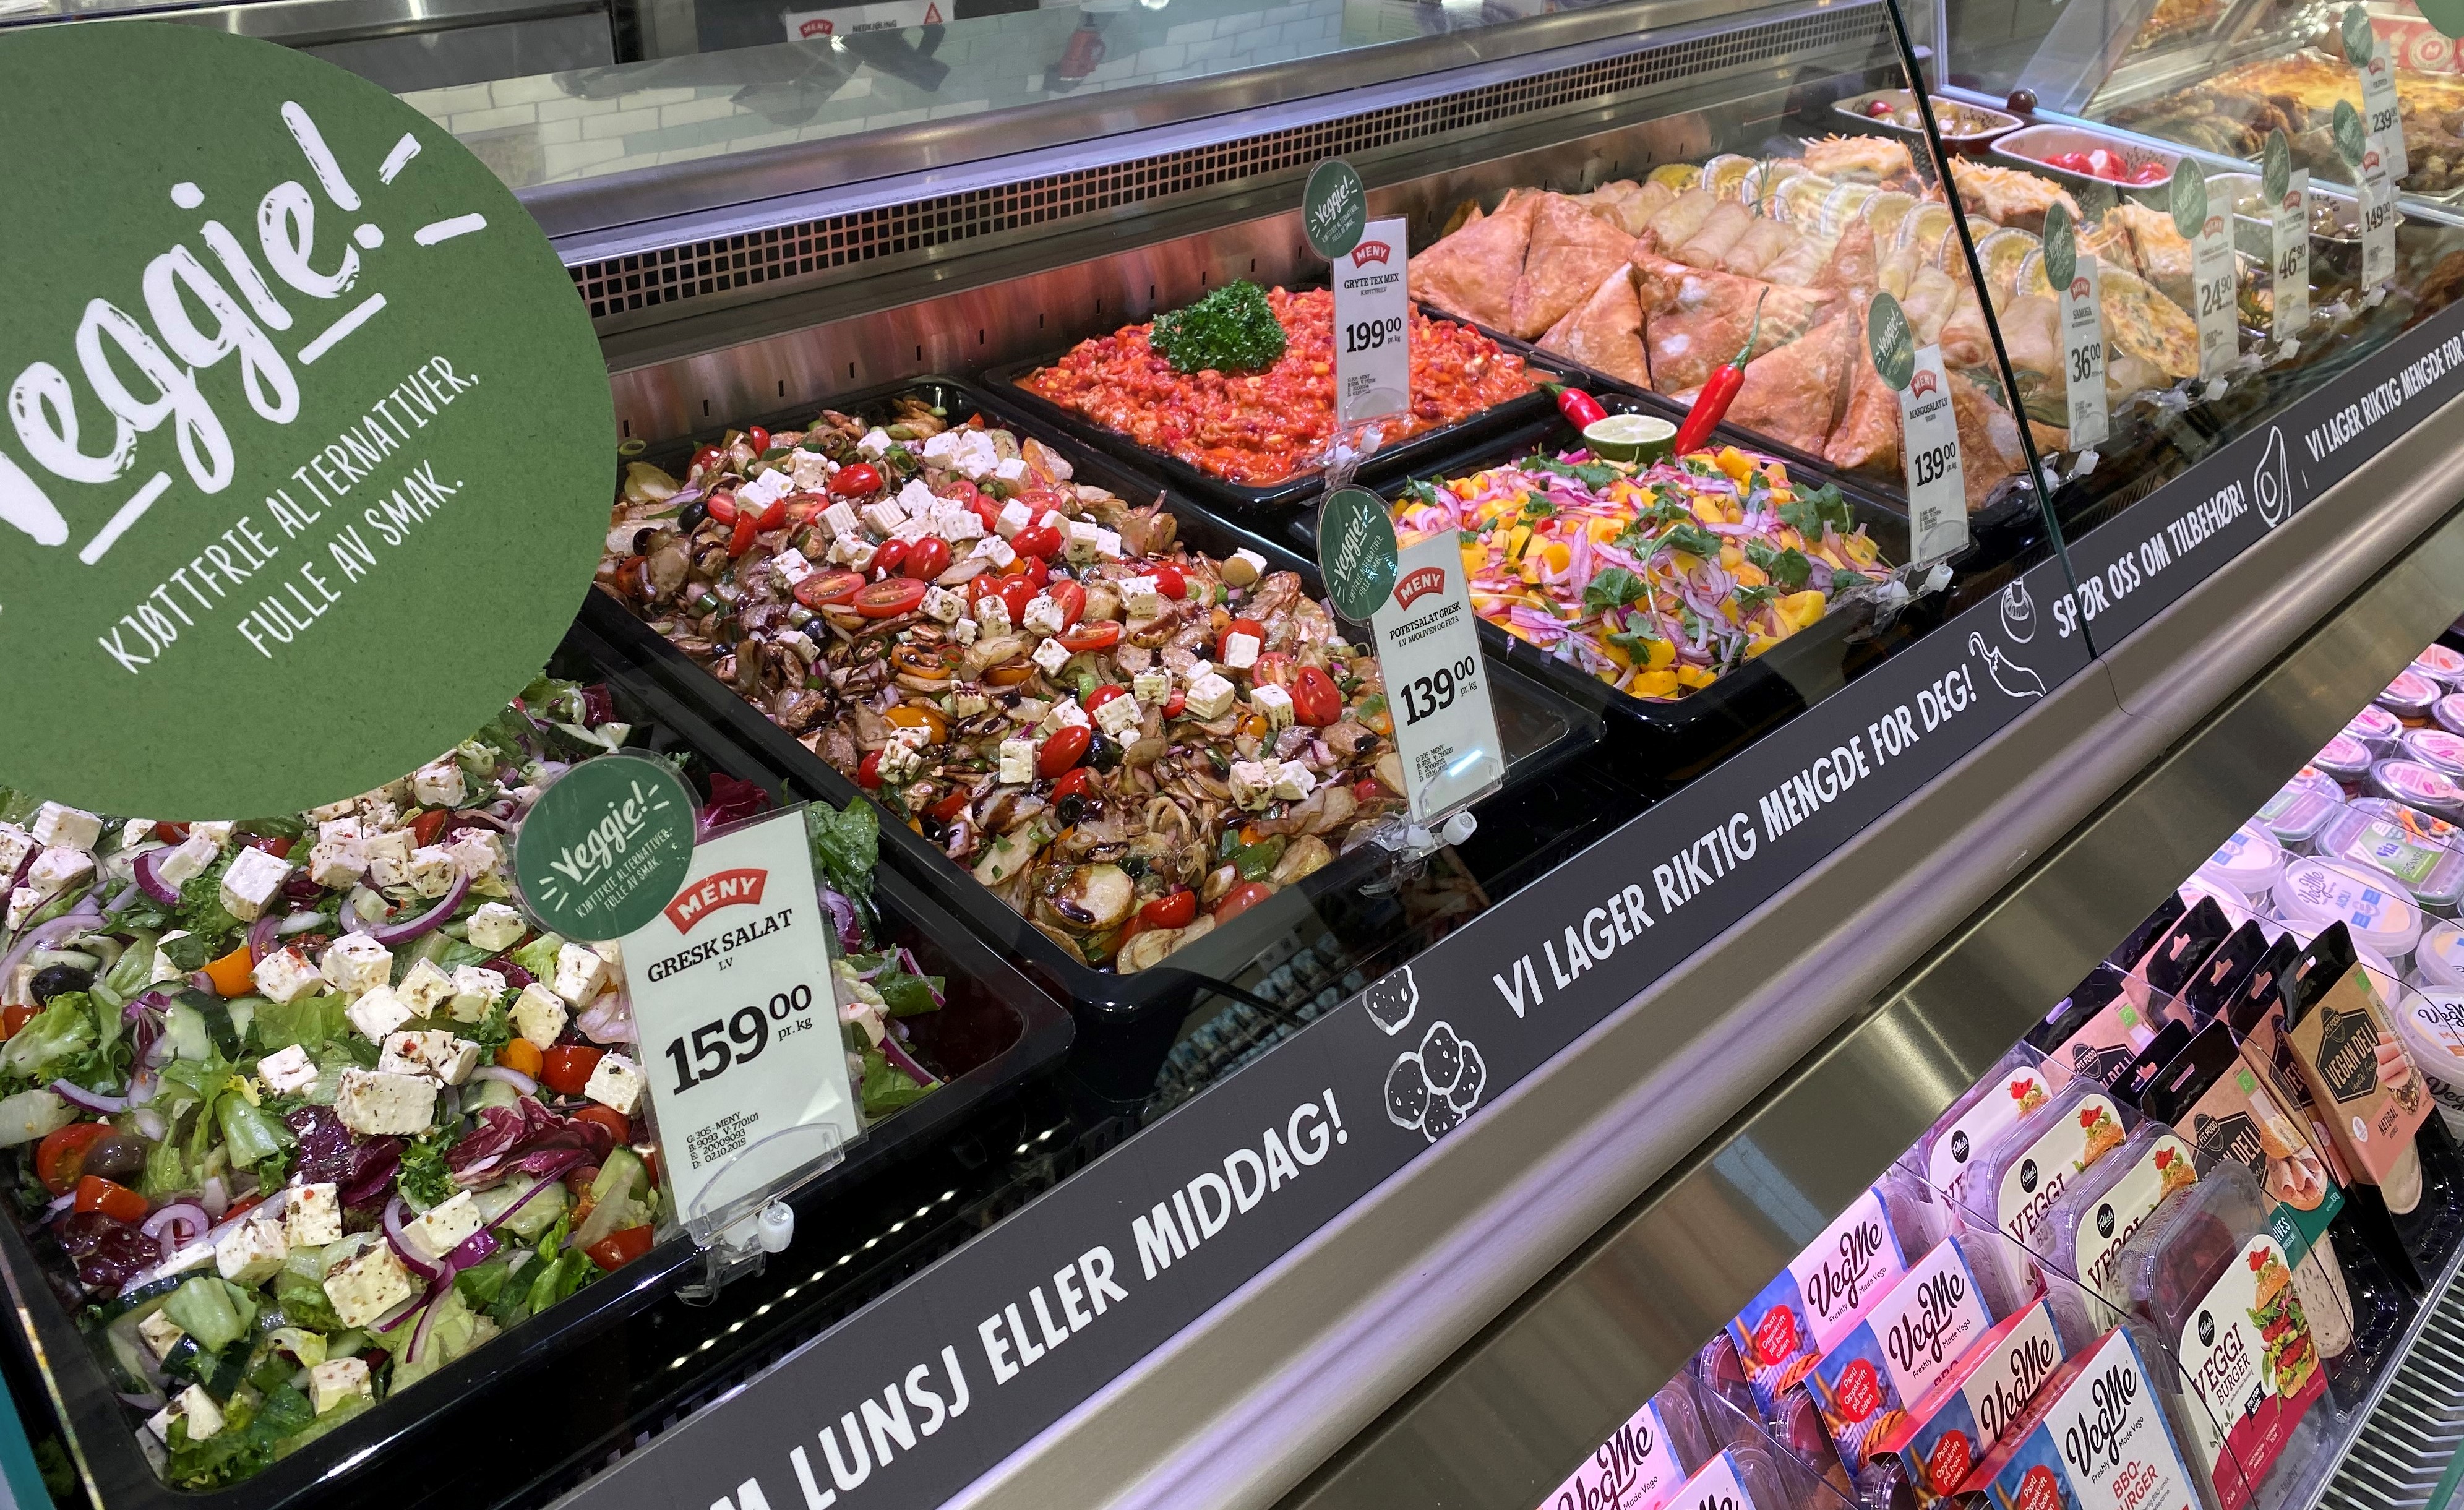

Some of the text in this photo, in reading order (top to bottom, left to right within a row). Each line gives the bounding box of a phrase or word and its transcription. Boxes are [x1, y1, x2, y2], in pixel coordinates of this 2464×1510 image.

[2372, 109, 2392, 132] 239
[1315, 174, 1350, 224] Veggie!
[2366, 206, 2384, 232] 149
[1357, 246, 1387, 262] MENY
[2279, 249, 2298, 280] 46
[1344, 273, 1399, 289] GRYTE TEX MEX
[2201, 280, 2223, 317] 24
[1346, 319, 1385, 353] 199
[1877, 307, 1899, 357] Veggie!
[1915, 374, 1934, 392] MENY
[2072, 345, 2092, 383] 36
[2305, 335, 2464, 463] VI LAGER RIKTIG MENGDE FOR
[1915, 447, 1944, 488] 139
[98, 354, 480, 674] KJØTTFRIE ALTERNATIVER,
[236, 459, 465, 659] FULLE AV SMAK.
[1334, 505, 1366, 580] Veggie!
[2053, 480, 2249, 638] SPØR OSS OM TILBEHØR!
[1400, 573, 1441, 601] MENY
[1389, 601, 1462, 640] POTETSALAT GRESK
[1399, 615, 1460, 648] LV M/OLIVEN OG FETA
[1401, 668, 1456, 726] 139
[550, 780, 649, 883] Veggie!
[1492, 663, 1978, 1019] VI LAGER RIKTIG MENGDE FOR DEG!
[575, 875, 619, 919] KJØTTFRIE
[604, 885, 629, 911] FULLE
[627, 874, 638, 891] AV
[677, 876, 758, 922] MENY
[647, 909, 793, 983] GRESK SALAT
[718, 956, 734, 972] LV
[665, 1006, 769, 1096] 159
[2075, 1049, 2097, 1071] FIT FOOD
[2325, 1021, 2379, 1090] VEGAN DELI
[715, 1111, 741, 1130] MENY
[2199, 1120, 2218, 1144] FIT FOOD
[2377, 1105, 2398, 1136] NATURAL
[703, 1128, 746, 1156] 20009093
[2230, 1125, 2264, 1167] DELI
[2009, 1172, 2068, 1244] VEGGI
[1806, 1219, 1884, 1318] VegMe
[790, 1089, 1348, 1510] LUNSJ ELLER MIDDAG!
[1829, 1265, 1887, 1324] Freshly Made Vego
[1762, 1315, 1787, 1349] Oppskrift
[1763, 1312, 1777, 1334] Psst!
[1887, 1270, 1965, 1373] VegMe
[1769, 1326, 1788, 1357] på bak-
[1775, 1337, 1790, 1359] siden
[1912, 1357, 1932, 1379] Freshly
[1941, 1332, 1958, 1349] Made
[1956, 1318, 1972, 1338] Vego
[1843, 1366, 1858, 1389] Psst!
[2193, 1321, 2245, 1404] VEGGI
[2217, 1352, 2251, 1407] BURGER
[1844, 1368, 1868, 1405] Oppskrift
[1852, 1381, 1871, 1413] på bak-
[1859, 1393, 1874, 1416] siden
[1981, 1336, 2054, 1443] VegMe
[2066, 1364, 2137, 1477] VegMe
[1936, 1438, 1951, 1462] Psst!
[1936, 1440, 1961, 1479] Oppskrift
[2092, 1415, 2144, 1485] Freshly Made Vego
[1641, 1476, 1659, 1493] Vego
[1943, 1453, 1962, 1486] på bak-
[1949, 1465, 1965, 1488] siden
[2023, 1474, 2037, 1499] Psst!
[2112, 1460, 2142, 1501] BBQ-
